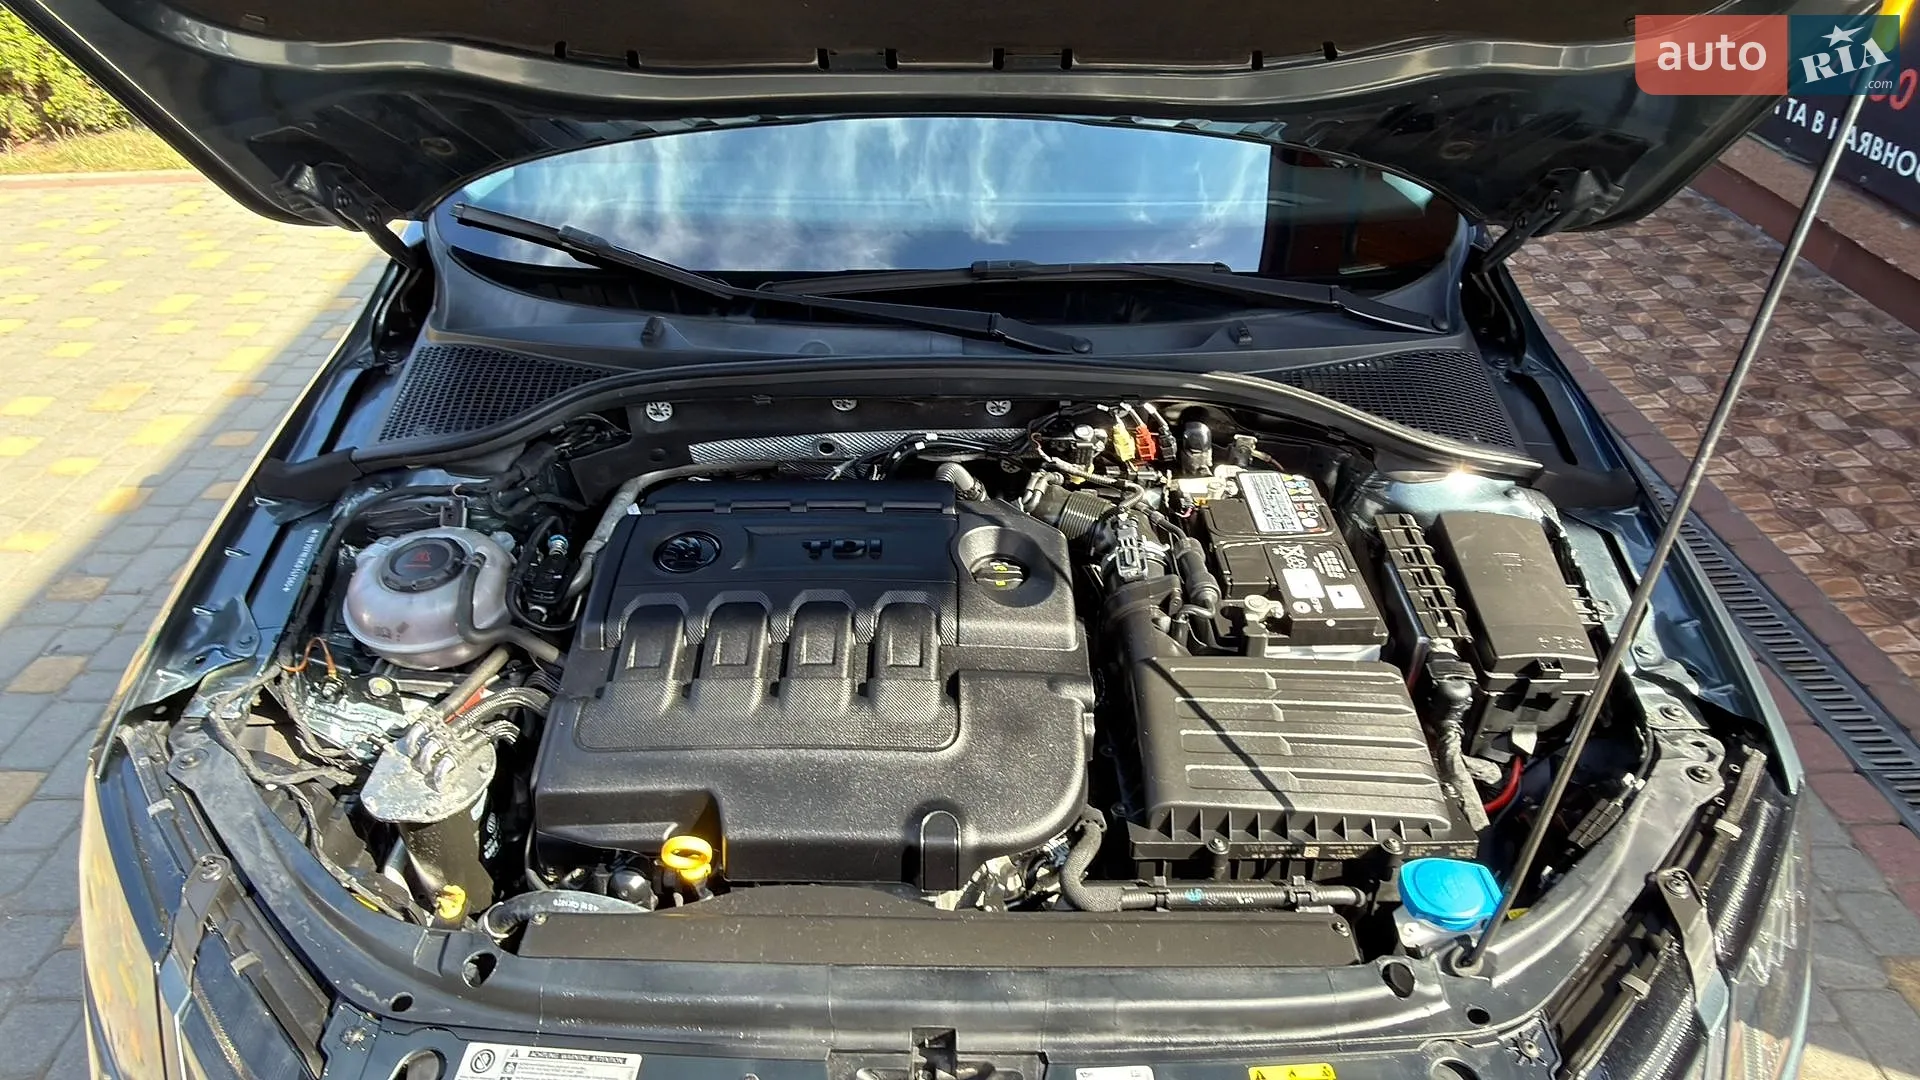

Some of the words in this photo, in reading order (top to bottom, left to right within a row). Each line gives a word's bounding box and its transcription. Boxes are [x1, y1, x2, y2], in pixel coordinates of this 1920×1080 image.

[1786, 97, 1807, 127] ТА
[1811, 110, 1826, 133] В
[801, 538, 883, 560] TDI
